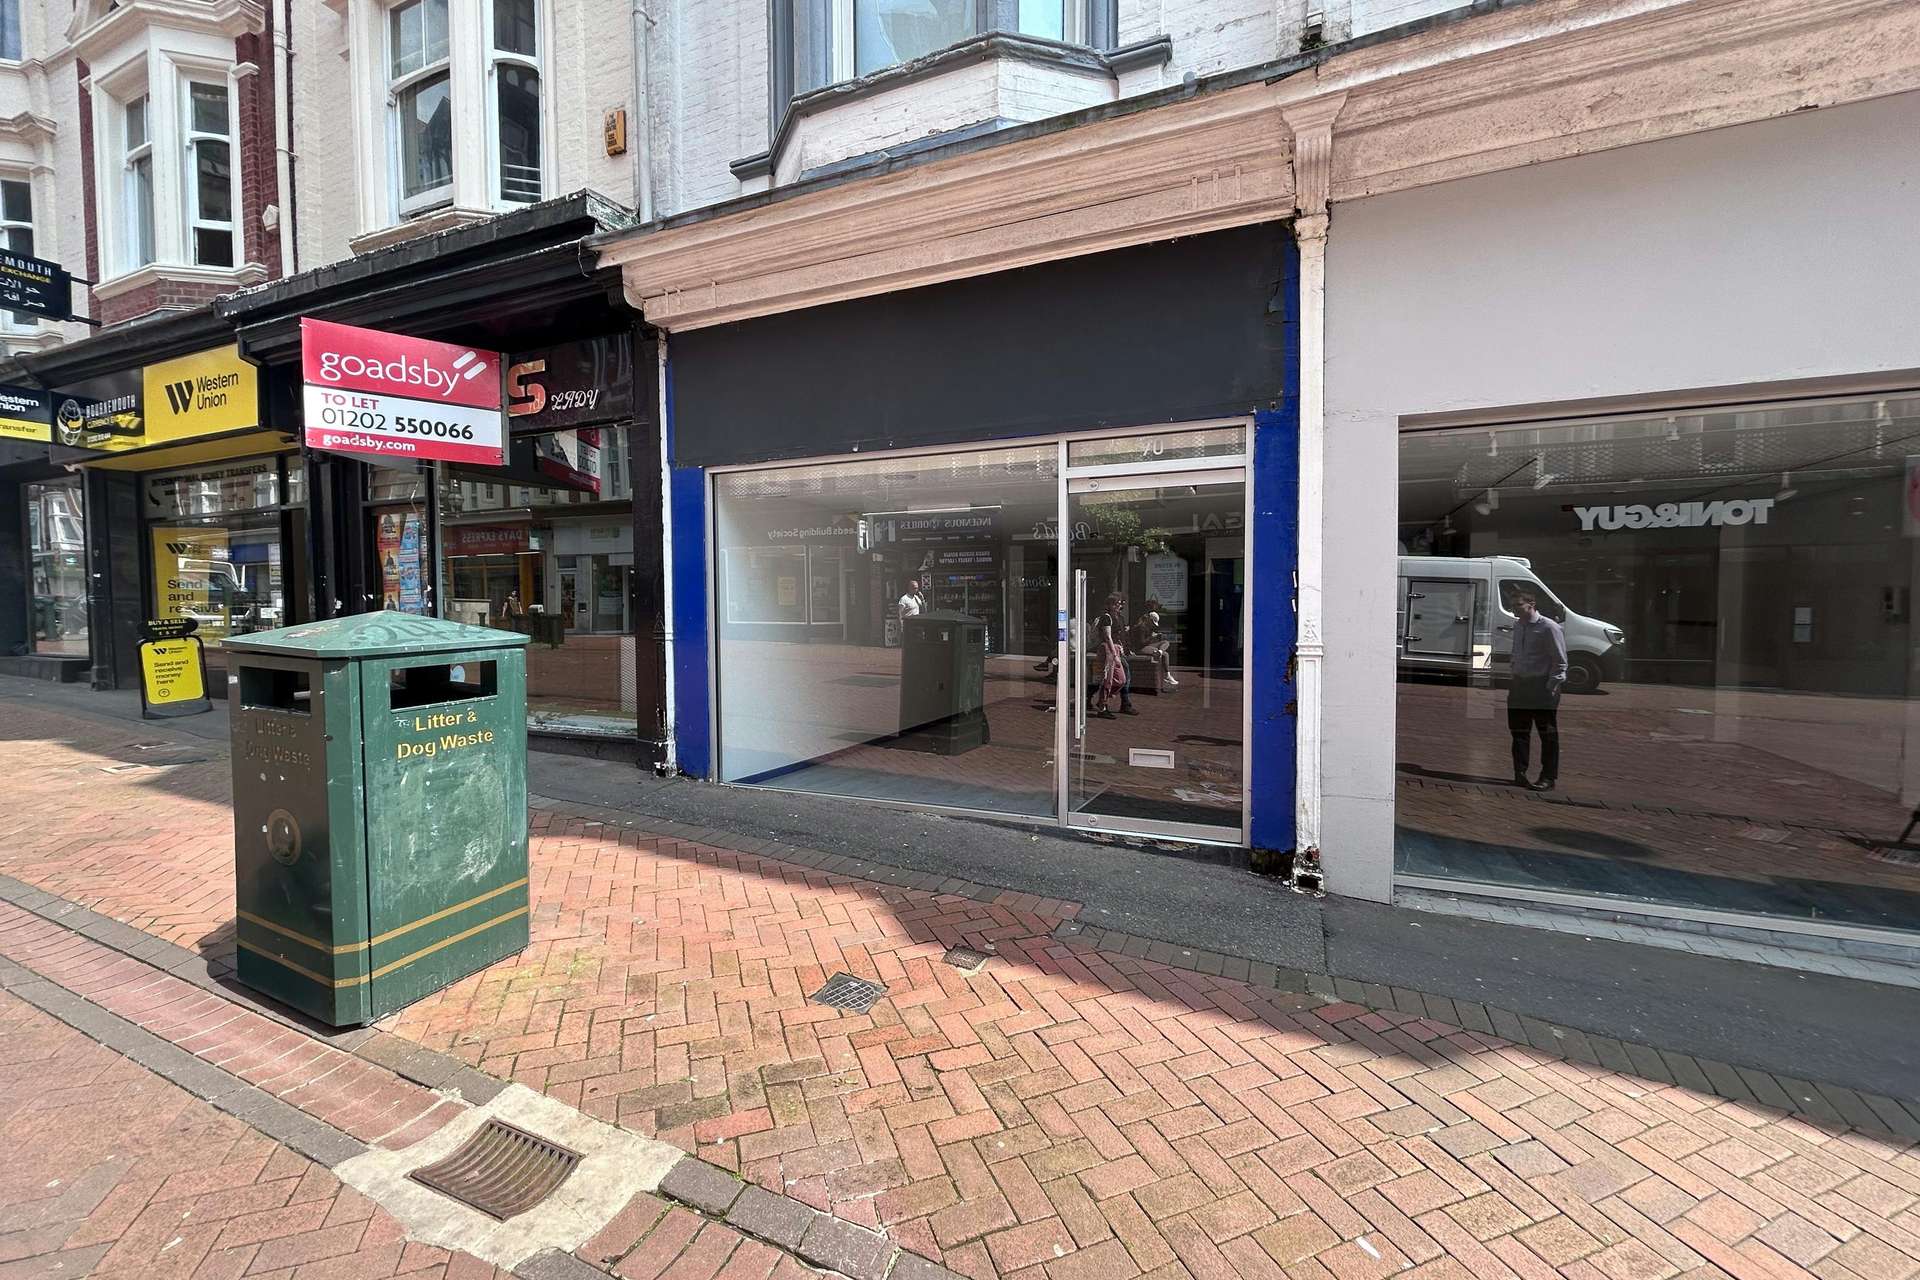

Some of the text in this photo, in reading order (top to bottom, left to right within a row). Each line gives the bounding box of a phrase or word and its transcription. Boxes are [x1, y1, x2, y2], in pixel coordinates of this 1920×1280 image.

[0, 255, 52, 277] MOUTH
[196, 372, 239, 393] Western
[320, 351, 460, 396] goadsby
[0, 394, 40, 407] estern
[0, 401, 26, 412] nion
[196, 391, 227, 410] Union
[321, 392, 380, 410] TO LET
[551, 388, 599, 411] LADY
[0, 424, 37, 433] ransfer
[322, 407, 474, 440] 01202 550066
[322, 434, 416, 452] goadsby.com
[226, 464, 267, 478] TRANSFERS
[168, 579, 203, 590] Send
[168, 591, 194, 602] and
[415, 710, 478, 732] Litter &
[396, 730, 494, 761] Dog Waste
